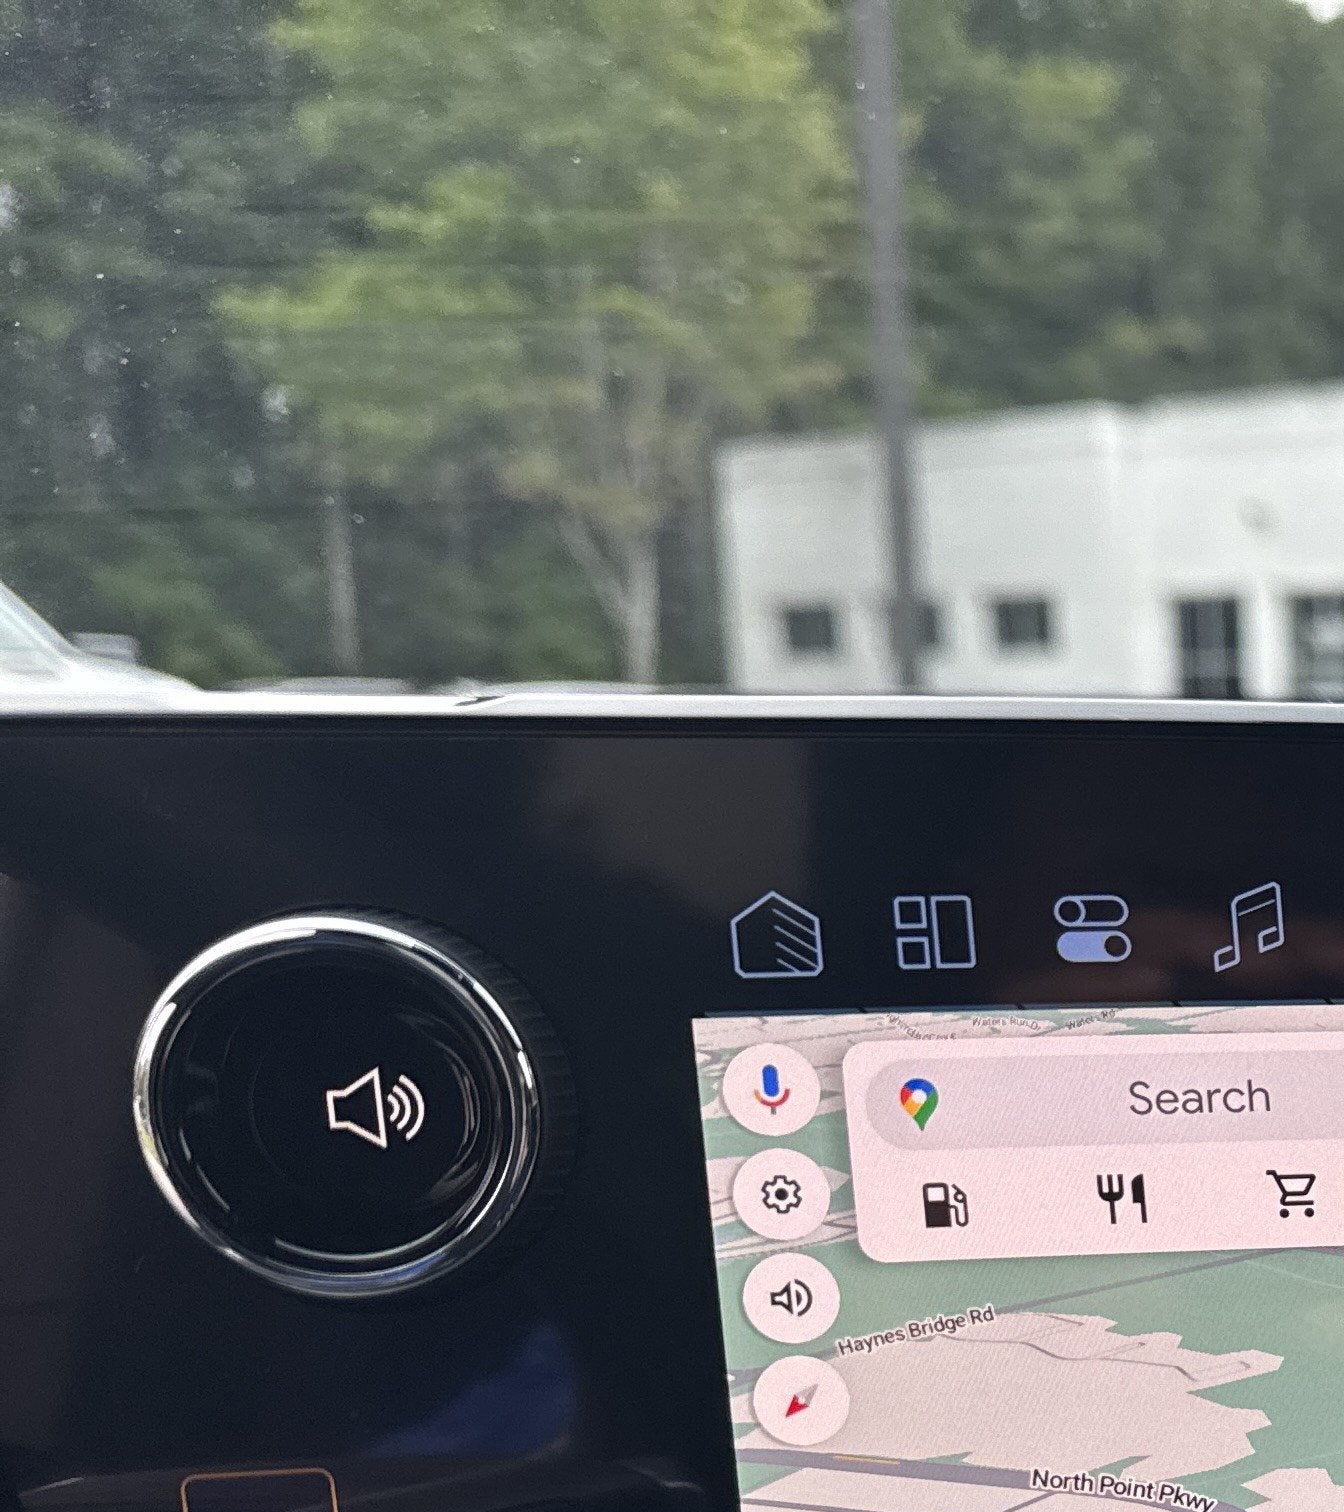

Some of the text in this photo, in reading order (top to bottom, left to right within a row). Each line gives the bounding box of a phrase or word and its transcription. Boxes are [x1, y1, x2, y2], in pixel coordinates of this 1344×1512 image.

[1128, 1078, 1272, 1119] Search
[837, 1305, 995, 1357] Haynes Bridge Rd
[1032, 1468, 1094, 1494] North
[1099, 1475, 1154, 1501] Point
